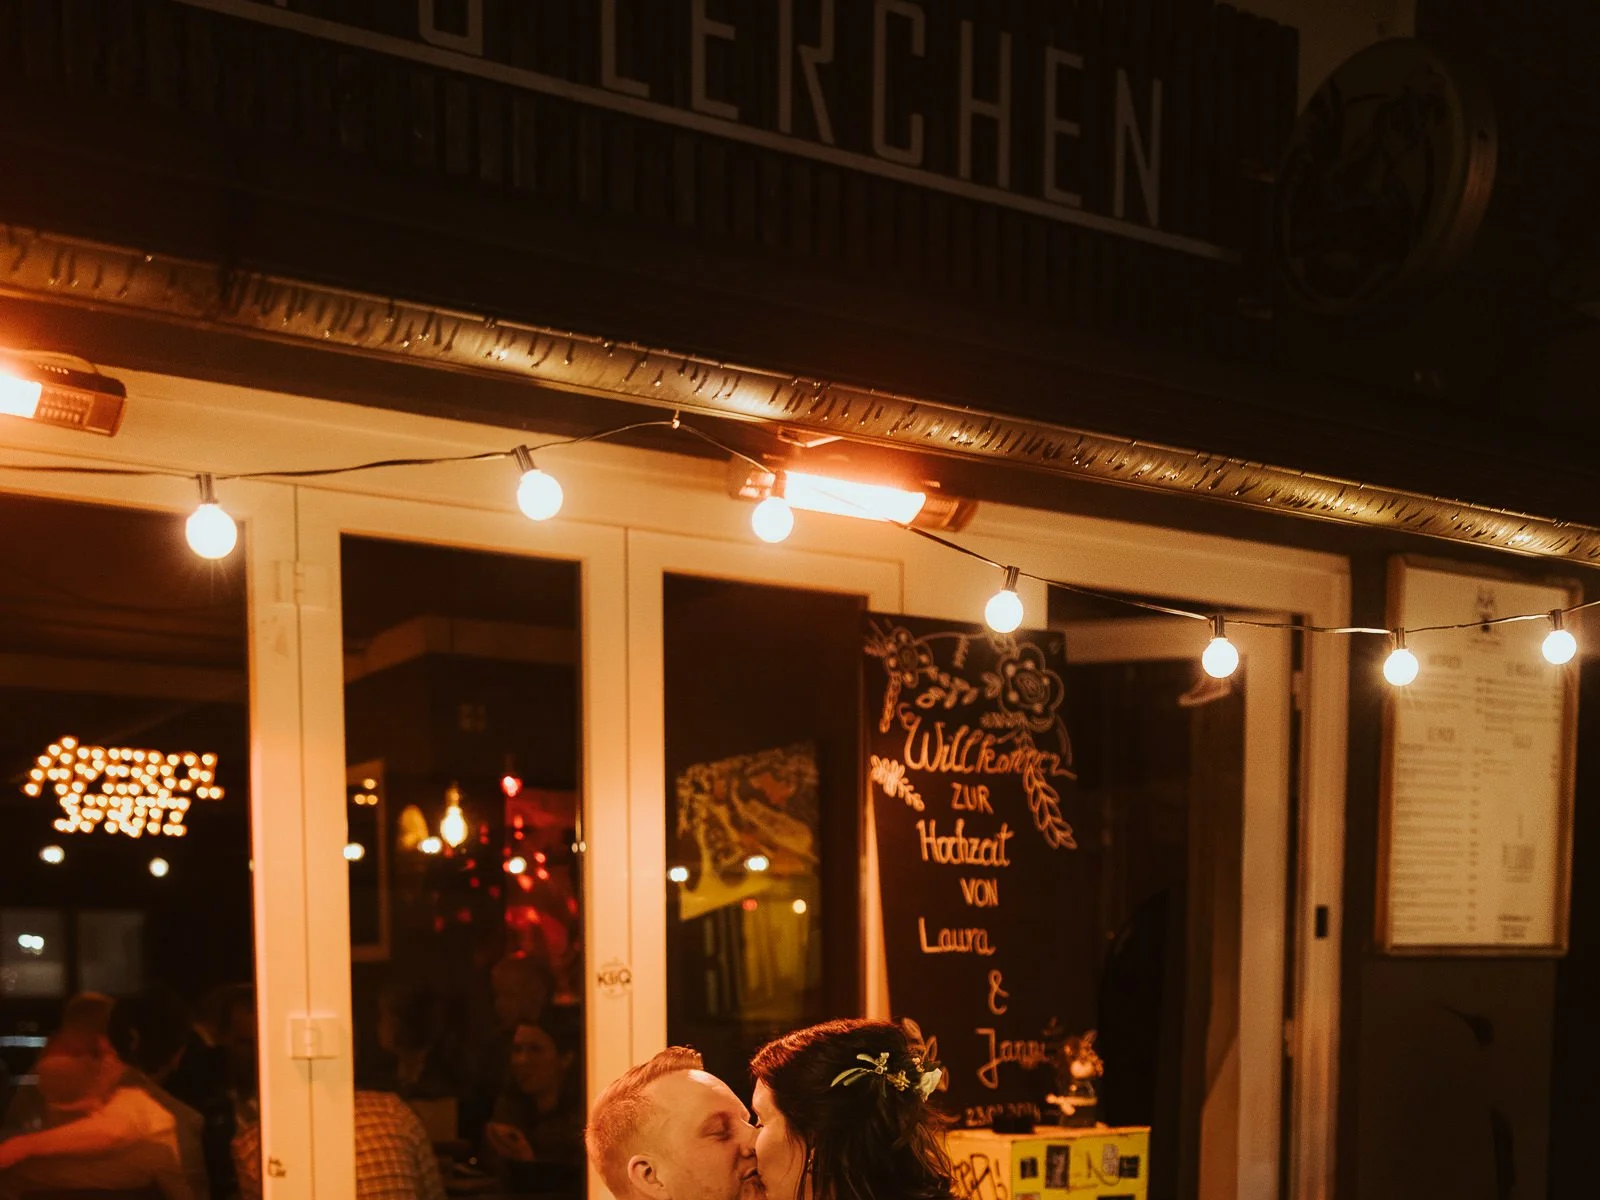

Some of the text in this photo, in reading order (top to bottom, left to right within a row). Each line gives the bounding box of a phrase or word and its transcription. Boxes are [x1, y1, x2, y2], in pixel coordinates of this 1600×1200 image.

[600, 0, 1164, 228] LERCHEN
[24, 736, 225, 800] APEROL
[951, 782, 994, 815] ZUR
[918, 917, 997, 956] Laura
[987, 969, 1010, 1015] &
